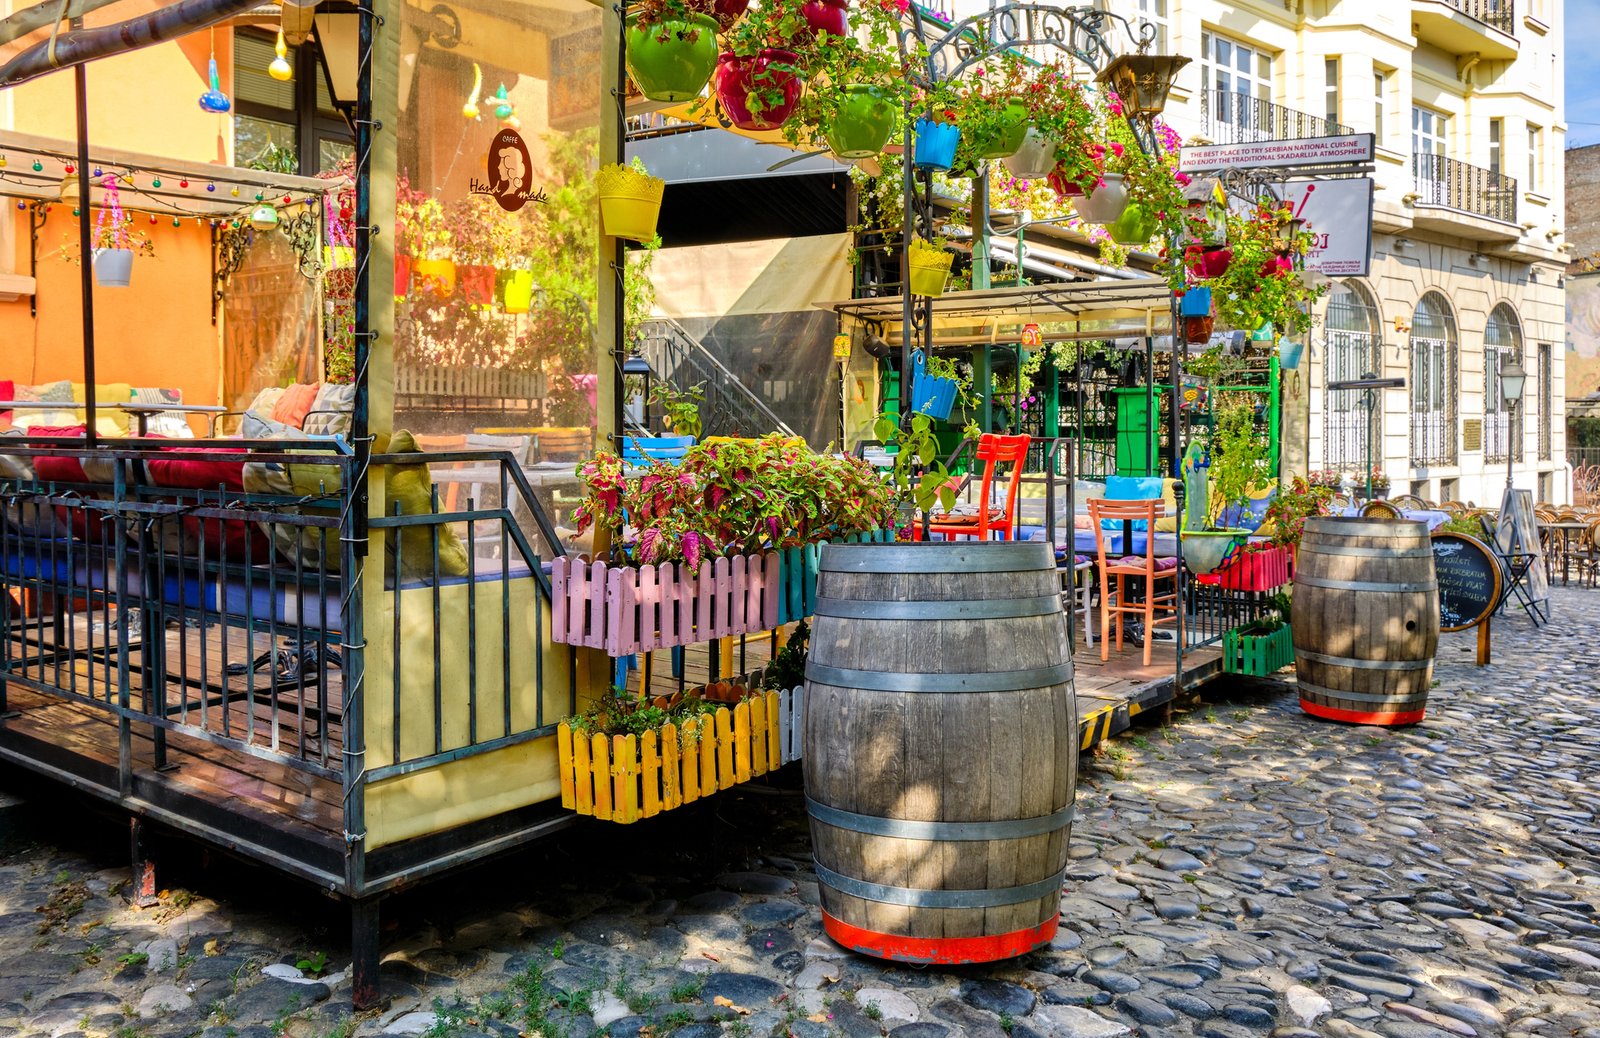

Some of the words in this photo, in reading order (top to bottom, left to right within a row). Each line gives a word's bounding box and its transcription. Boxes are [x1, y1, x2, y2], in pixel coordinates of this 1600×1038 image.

[502, 135, 518, 144] CAFFE
[1264, 145, 1293, 153] SERBIAN
[1294, 143, 1329, 151] NATIONAL
[1330, 140, 1358, 149] CUISINE
[1232, 154, 1275, 163] TRADITIONAL
[1276, 151, 1318, 160] SKADARLIJA
[1320, 148, 1367, 157] ATMOSPHERE
[470, 177, 501, 194] Hand
[518, 186, 548, 201] made
